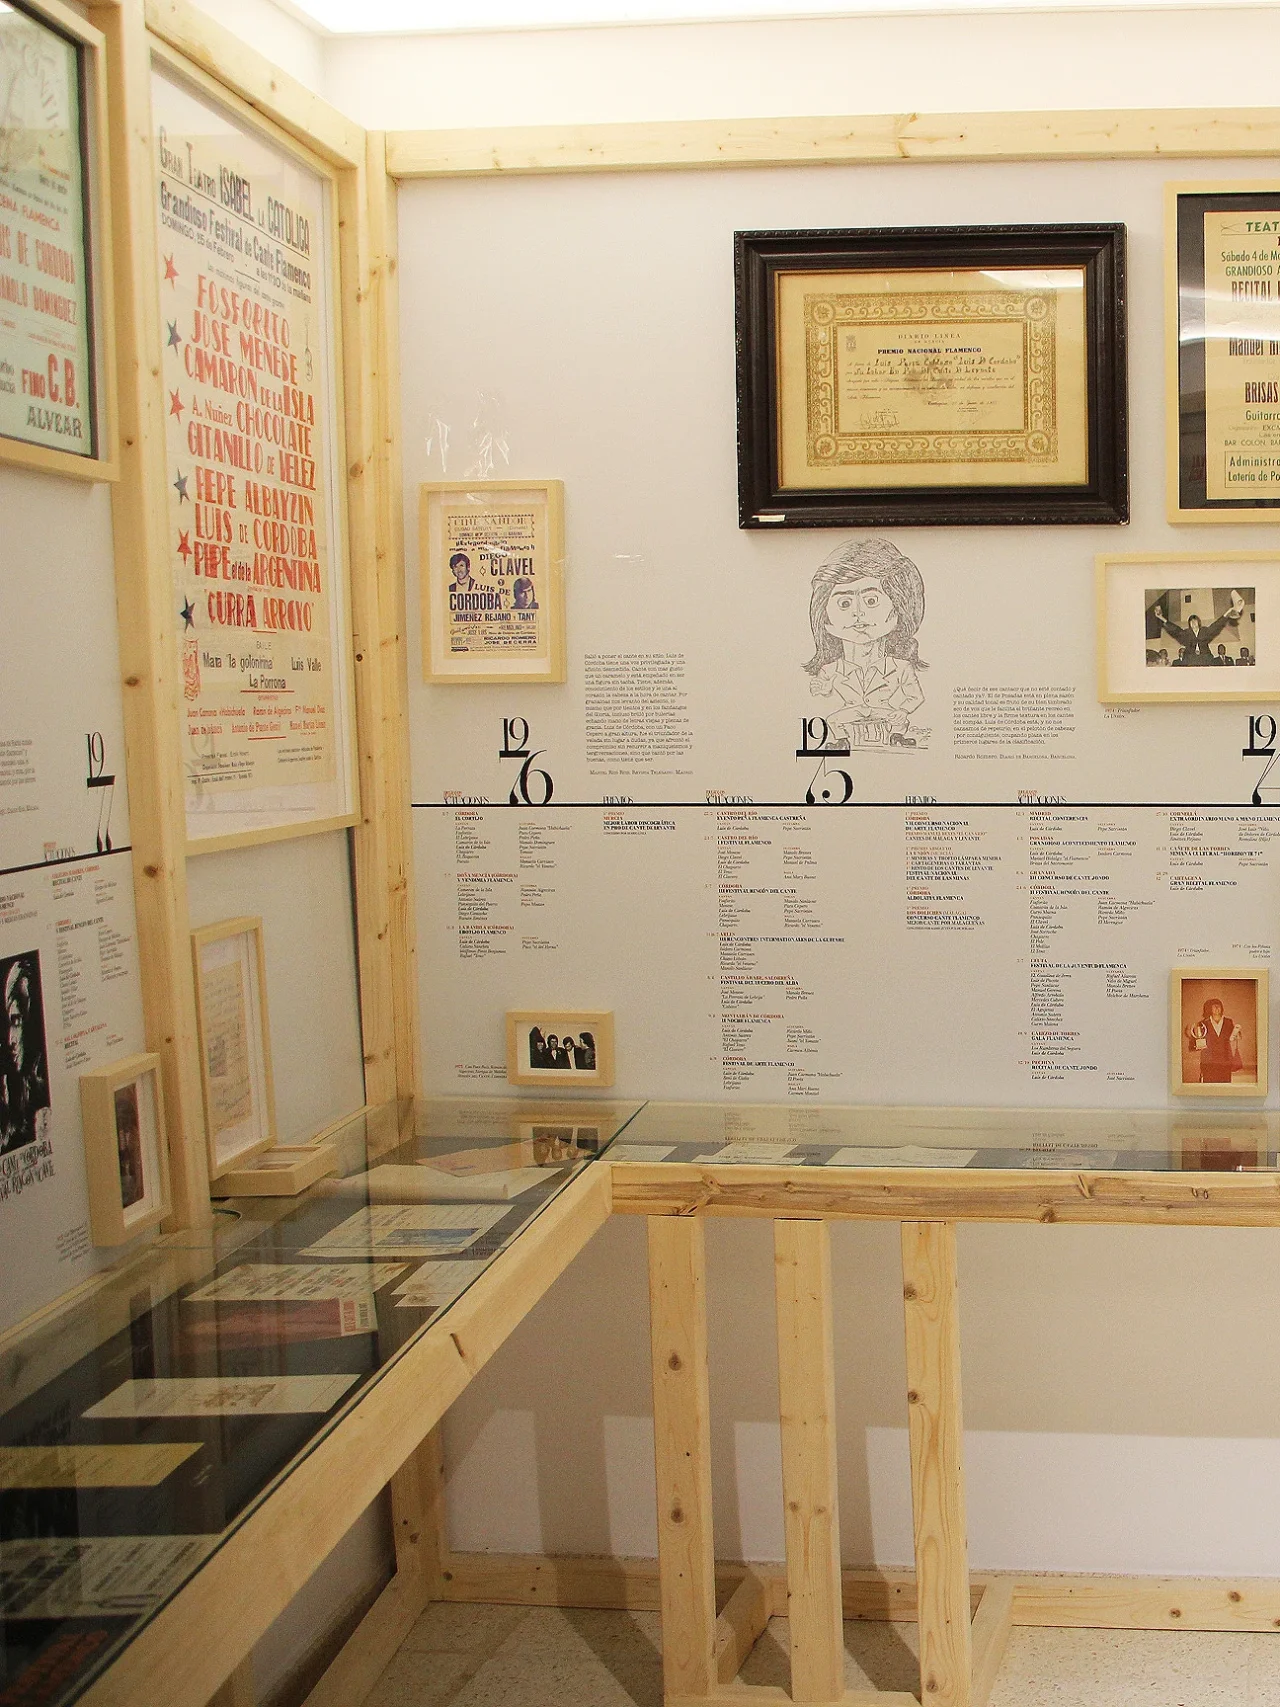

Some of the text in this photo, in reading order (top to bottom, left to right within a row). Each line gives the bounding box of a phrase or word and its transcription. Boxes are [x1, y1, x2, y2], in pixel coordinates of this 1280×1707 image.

[219, 163, 310, 256] ISABEL CATOLICA
[209, 208, 243, 254] Festival
[276, 249, 311, 290] Flamenco
[1221, 251, 1250, 262] Sábado
[1252, 252, 1257, 261] 4
[1259, 250, 1268, 261] de
[1225, 265, 1273, 276] GRANDIOSO
[1232, 280, 1271, 301] RECITAL
[197, 274, 290, 348] FOSFORITO
[191, 309, 298, 386] JOSE MENESE
[184, 343, 315, 426] CAMARON DE LA ISLA
[1245, 381, 1279, 403] BRISAS
[26, 406, 83, 440] ALVEAR
[236, 401, 313, 458] CHOCOLATE
[187, 420, 316, 490] GITANILLO DE VELEZ
[1228, 471, 1256, 482] Lotería
[1258, 471, 1268, 481] de
[245, 479, 314, 526] ALBAYZIN
[194, 503, 317, 560] LUIS DE CORDOBA
[253, 553, 321, 593] ARGENTINA
[490, 558, 535, 576] CLAVEL
[450, 593, 502, 611] CORDOBA
[474, 583, 511, 596] LUIS DE
[453, 612, 535, 622] JIMENEZ REJANO TANY
[291, 657, 304, 671] Luis
[249, 674, 258, 688] La
